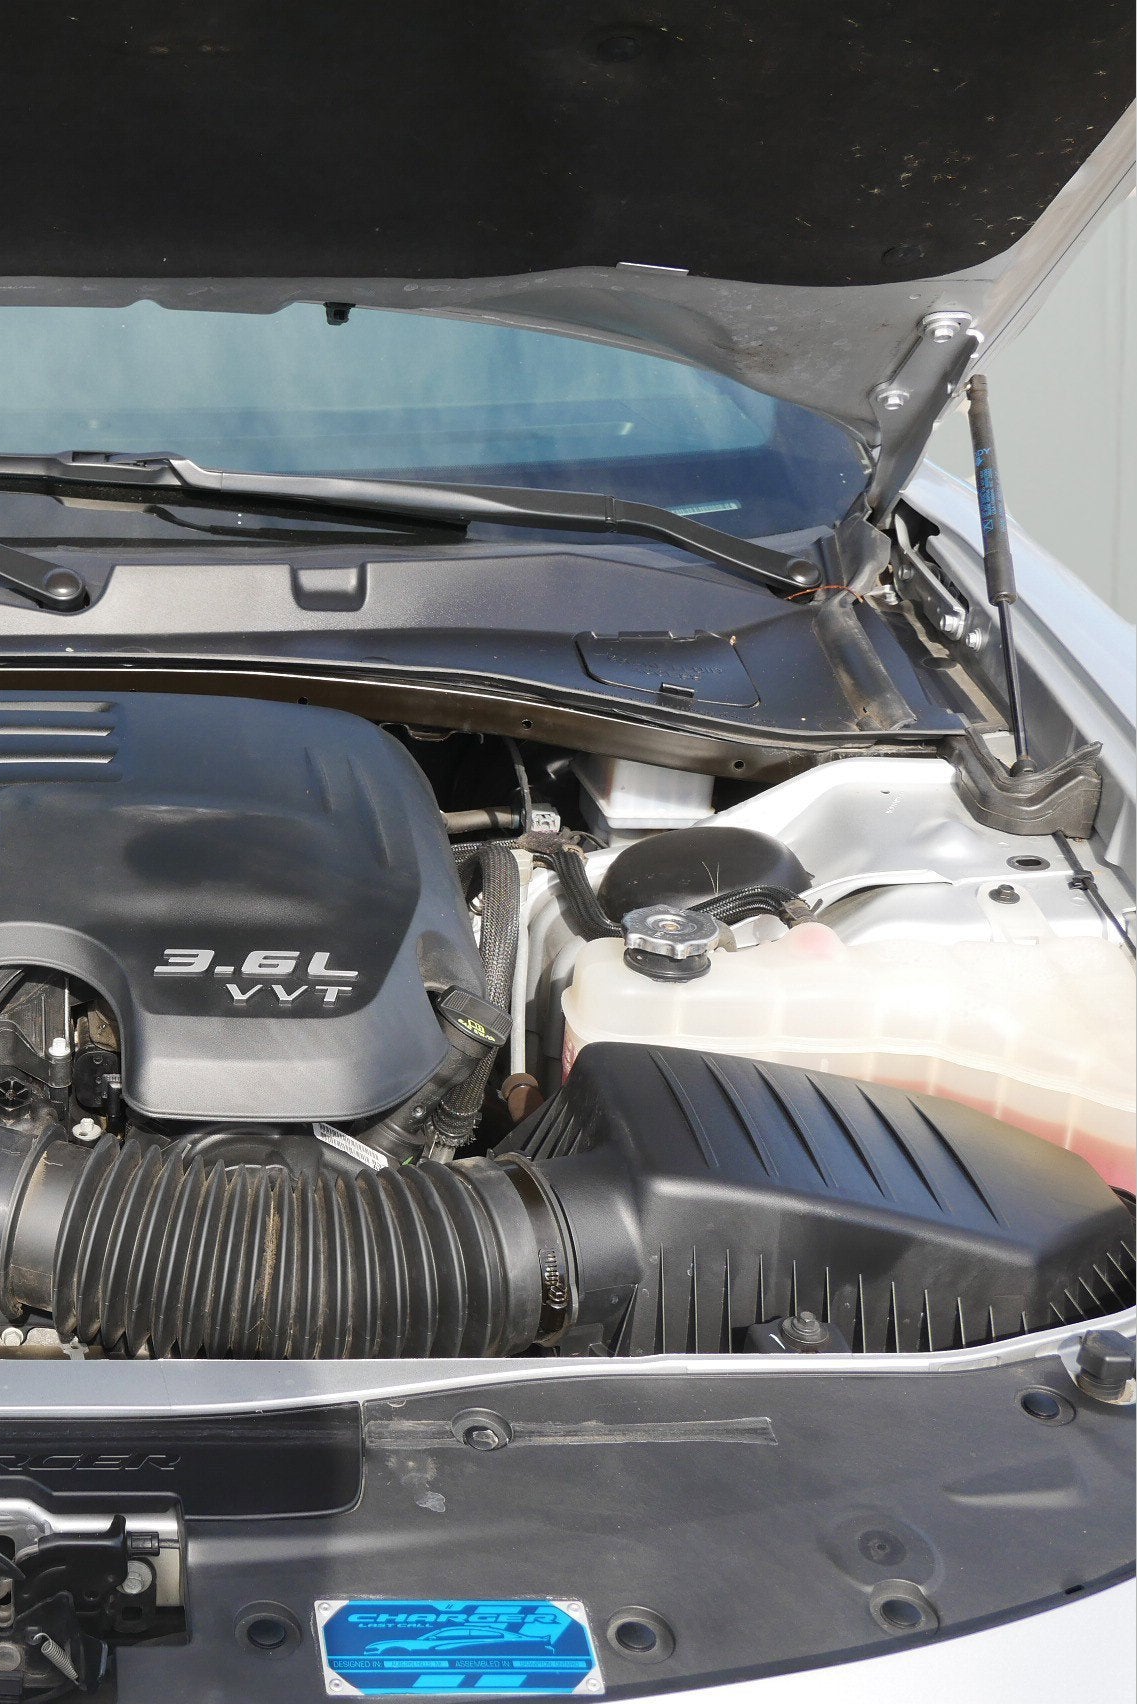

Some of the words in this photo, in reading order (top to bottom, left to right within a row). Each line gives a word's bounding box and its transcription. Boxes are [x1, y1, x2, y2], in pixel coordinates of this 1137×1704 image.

[154, 948, 360, 980] 3.6L
[225, 983, 353, 1007] VVT
[347, 1613, 561, 1624] CHARGER
[333, 1660, 370, 1668] DESIGNED
[455, 1660, 500, 1668] ASSEMBLED
